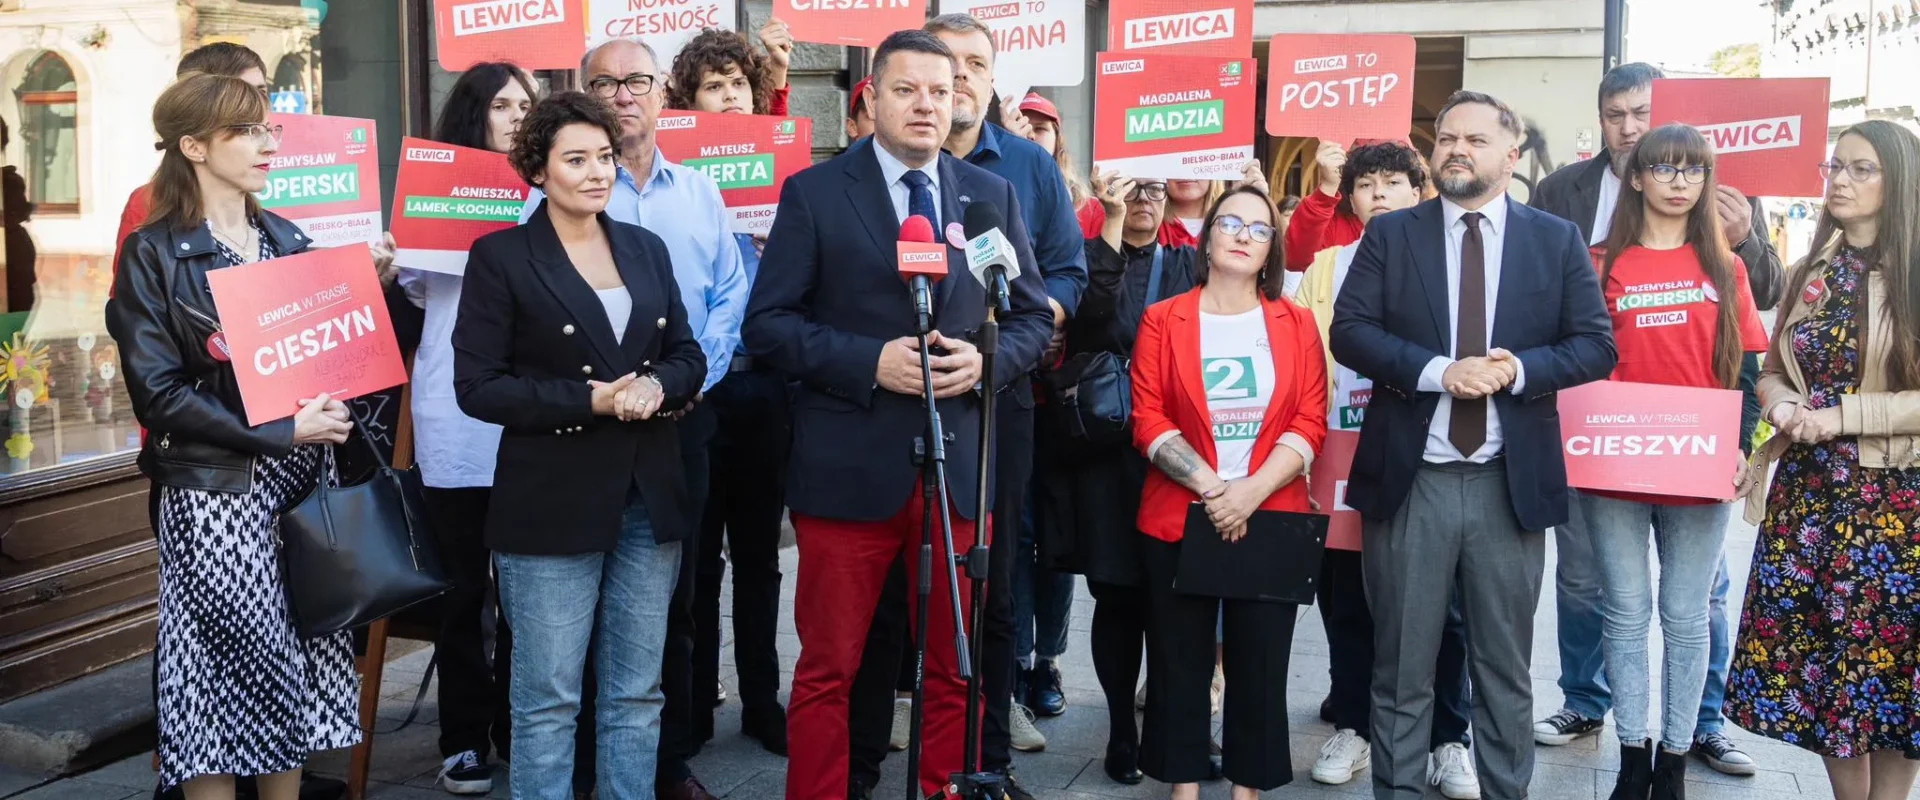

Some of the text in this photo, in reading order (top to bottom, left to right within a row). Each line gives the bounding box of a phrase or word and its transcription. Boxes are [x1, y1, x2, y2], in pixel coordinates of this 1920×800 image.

[460, 0, 559, 29] LEWICA
[970, 1, 1045, 19] LEWICA TO
[605, 4, 719, 37] CZESNOŚĆ
[1131, 14, 1228, 43] LEWICA
[1105, 61, 1142, 73] LEWICA
[1297, 52, 1377, 71] LEWICA TO
[1139, 89, 1212, 105] MAGDALENA
[1280, 73, 1398, 112] POSTĘP
[656, 117, 694, 128] LEWICA
[1129, 107, 1220, 135] MADZIA
[408, 150, 451, 160] LEWICA
[700, 143, 756, 157] MATEUSZ
[269, 153, 337, 169] ZEMYSŁAW
[1182, 152, 1245, 165] BIELSKO-BIAŁA
[255, 171, 356, 201] OPERSKI
[450, 186, 522, 199] AGNIESZKA
[406, 201, 522, 216] LAMEK-KOCHANO
[736, 210, 776, 220] BIELSKO-
[904, 253, 941, 262] LEWICA
[1625, 280, 1694, 293] PRZEMYSŁAW
[257, 282, 350, 327] LEWICA W TRASIE
[1639, 313, 1684, 325] LEWICA
[253, 304, 376, 376] CIESZYN
[1205, 358, 1249, 398] 2
[1586, 413, 1699, 424] LEWICA W TRASIE
[1565, 434, 1718, 456] CIESZYN
